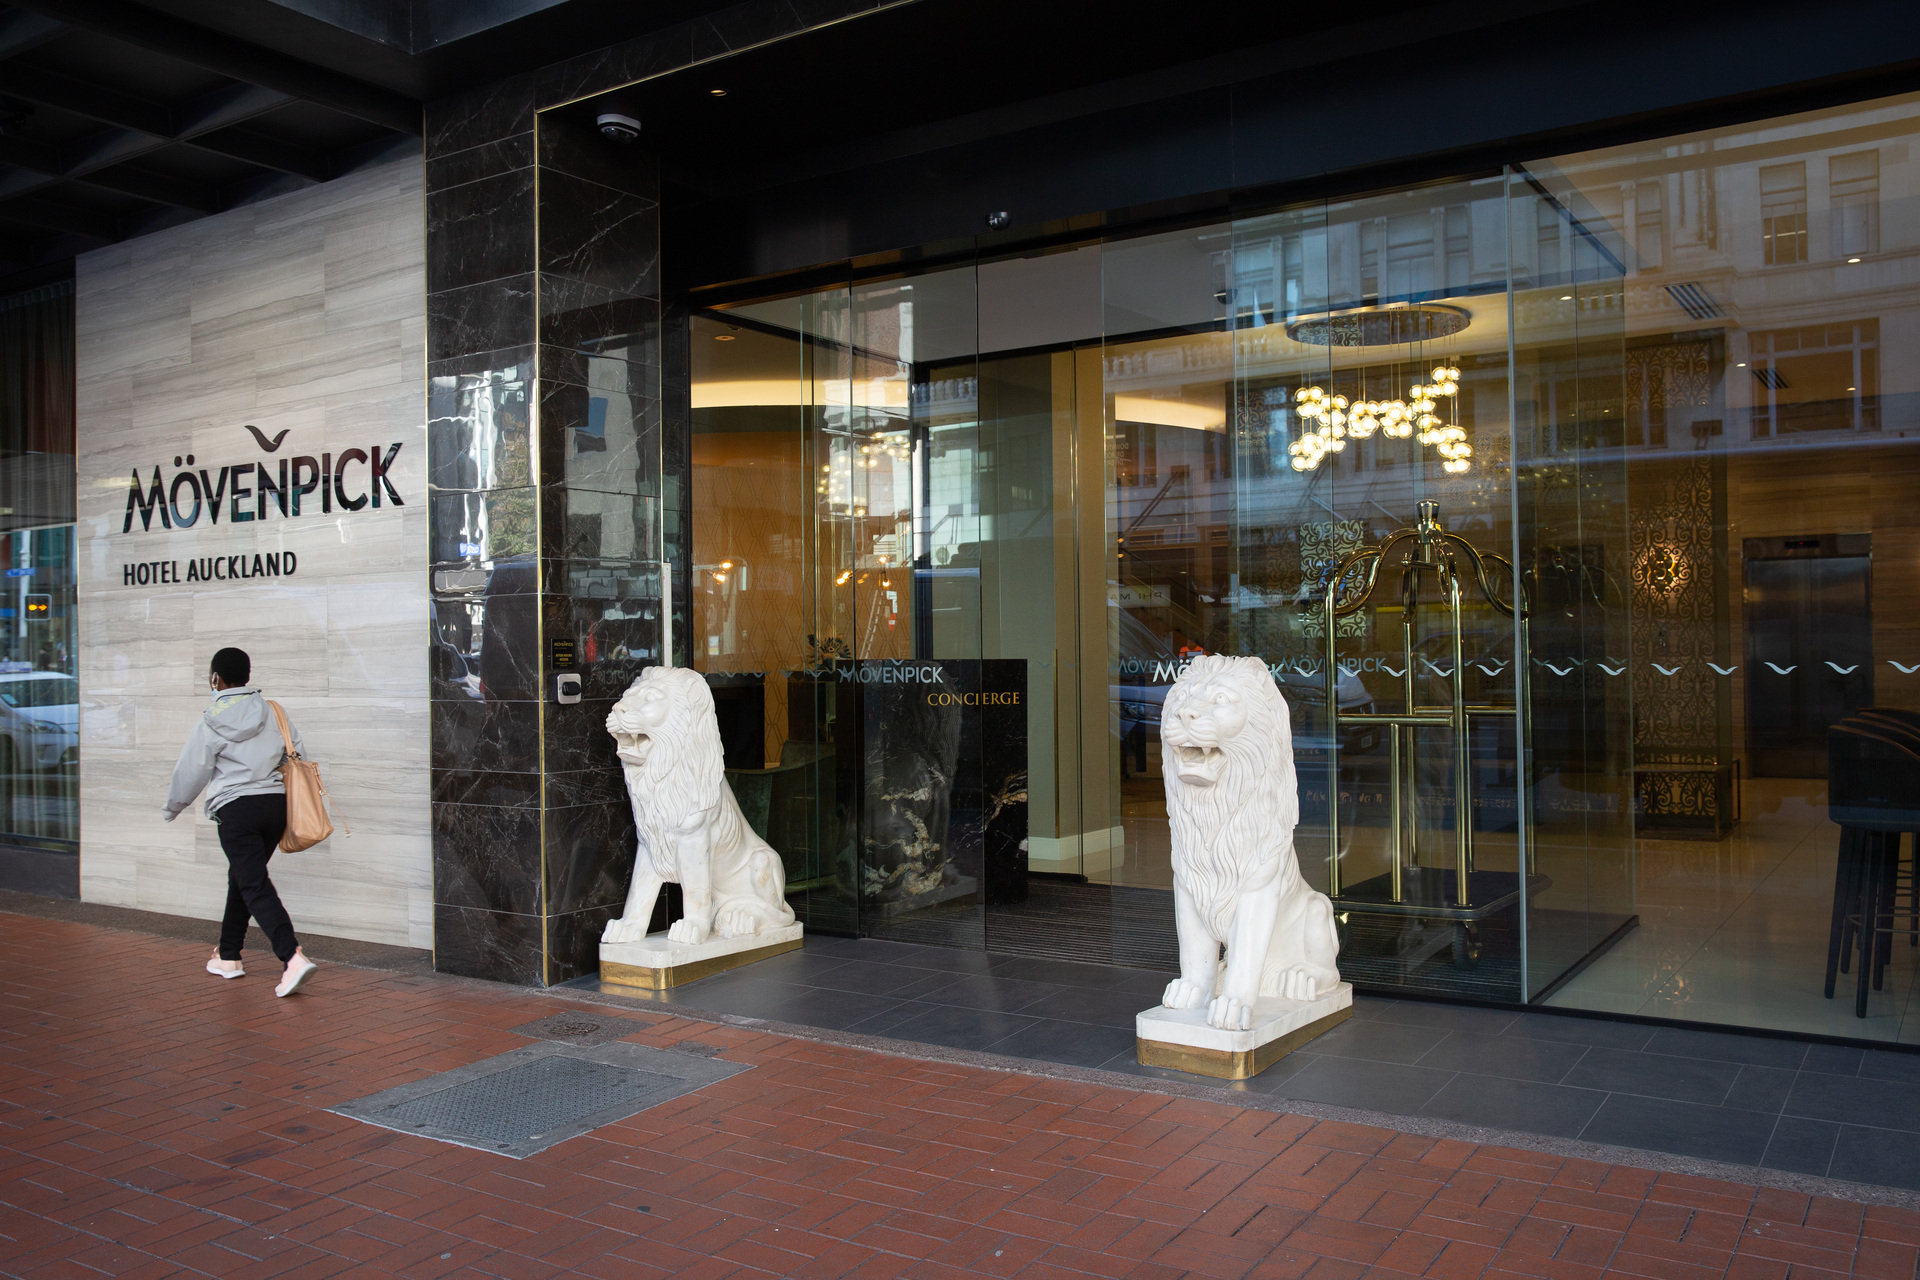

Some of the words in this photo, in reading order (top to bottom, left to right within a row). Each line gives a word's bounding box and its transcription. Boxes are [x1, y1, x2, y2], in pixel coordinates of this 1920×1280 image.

[122, 442, 405, 534] MÖVENPICK
[123, 561, 181, 586] HOTEL
[186, 551, 298, 582] AUCKLAND
[838, 662, 944, 684] MÖVENPICK
[927, 691, 1021, 707] CONCIERGE
